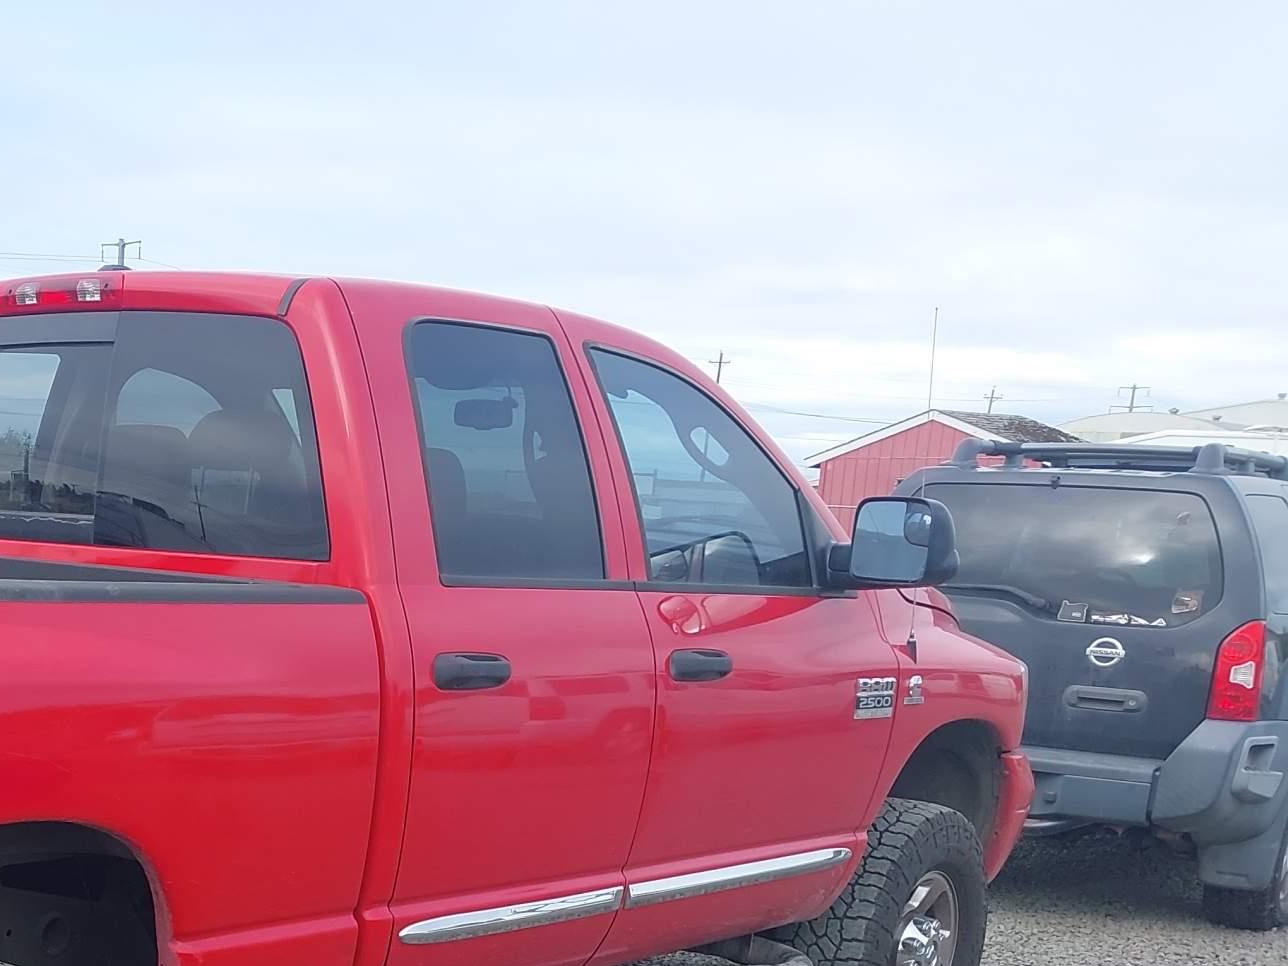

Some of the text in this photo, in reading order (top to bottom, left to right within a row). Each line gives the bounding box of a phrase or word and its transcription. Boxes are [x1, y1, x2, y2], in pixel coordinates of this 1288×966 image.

[1089, 649, 1121, 657] NISSAN
[857, 677, 896, 693] RAM
[859, 696, 891, 708] 2500
